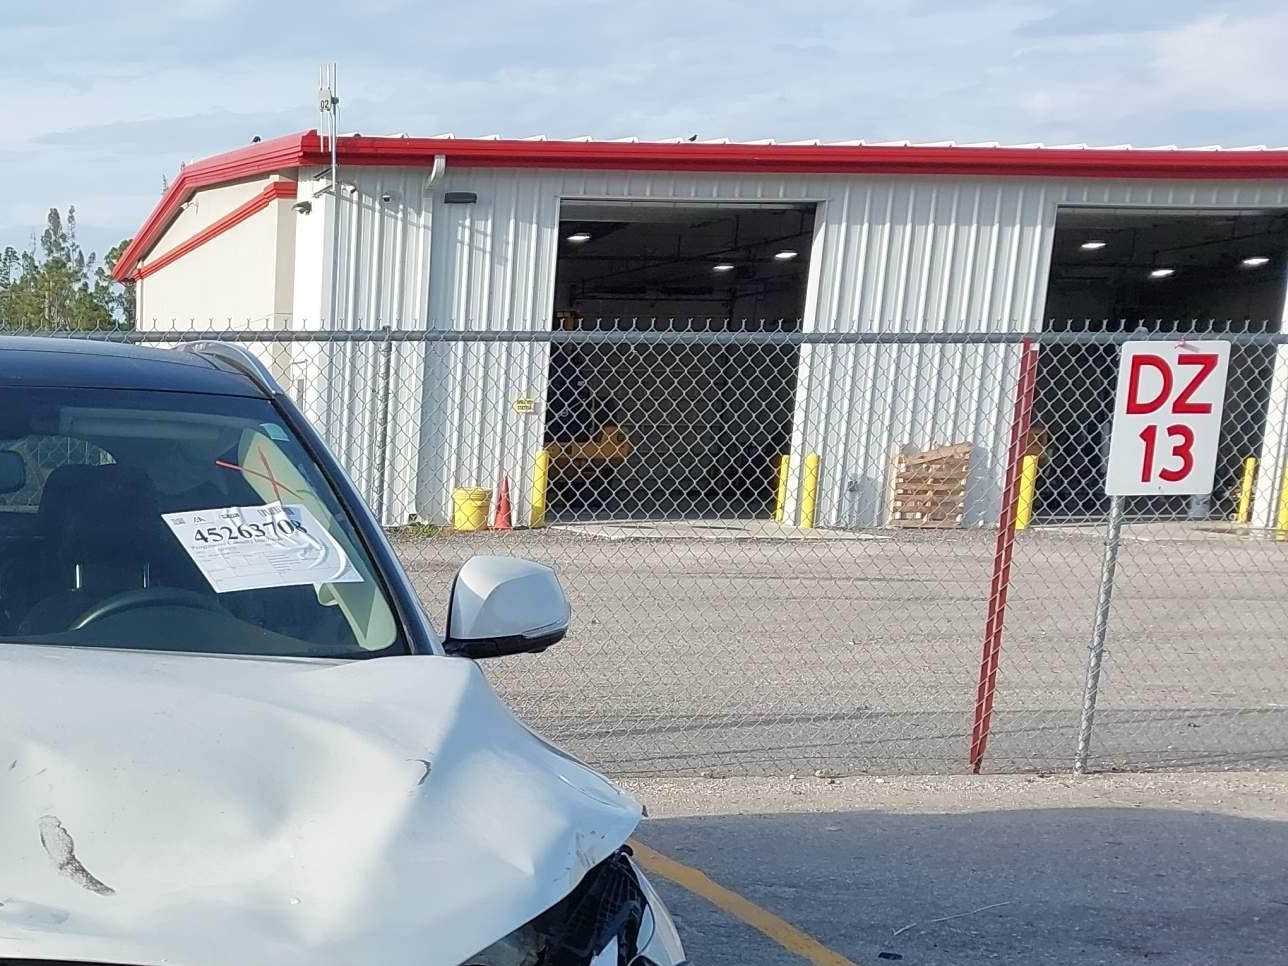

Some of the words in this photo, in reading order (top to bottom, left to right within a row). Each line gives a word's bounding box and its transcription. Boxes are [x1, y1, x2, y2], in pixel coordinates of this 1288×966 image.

[1125, 353, 1219, 415] DZ
[1138, 423, 1195, 483] 13
[194, 519, 308, 543] 45263708
